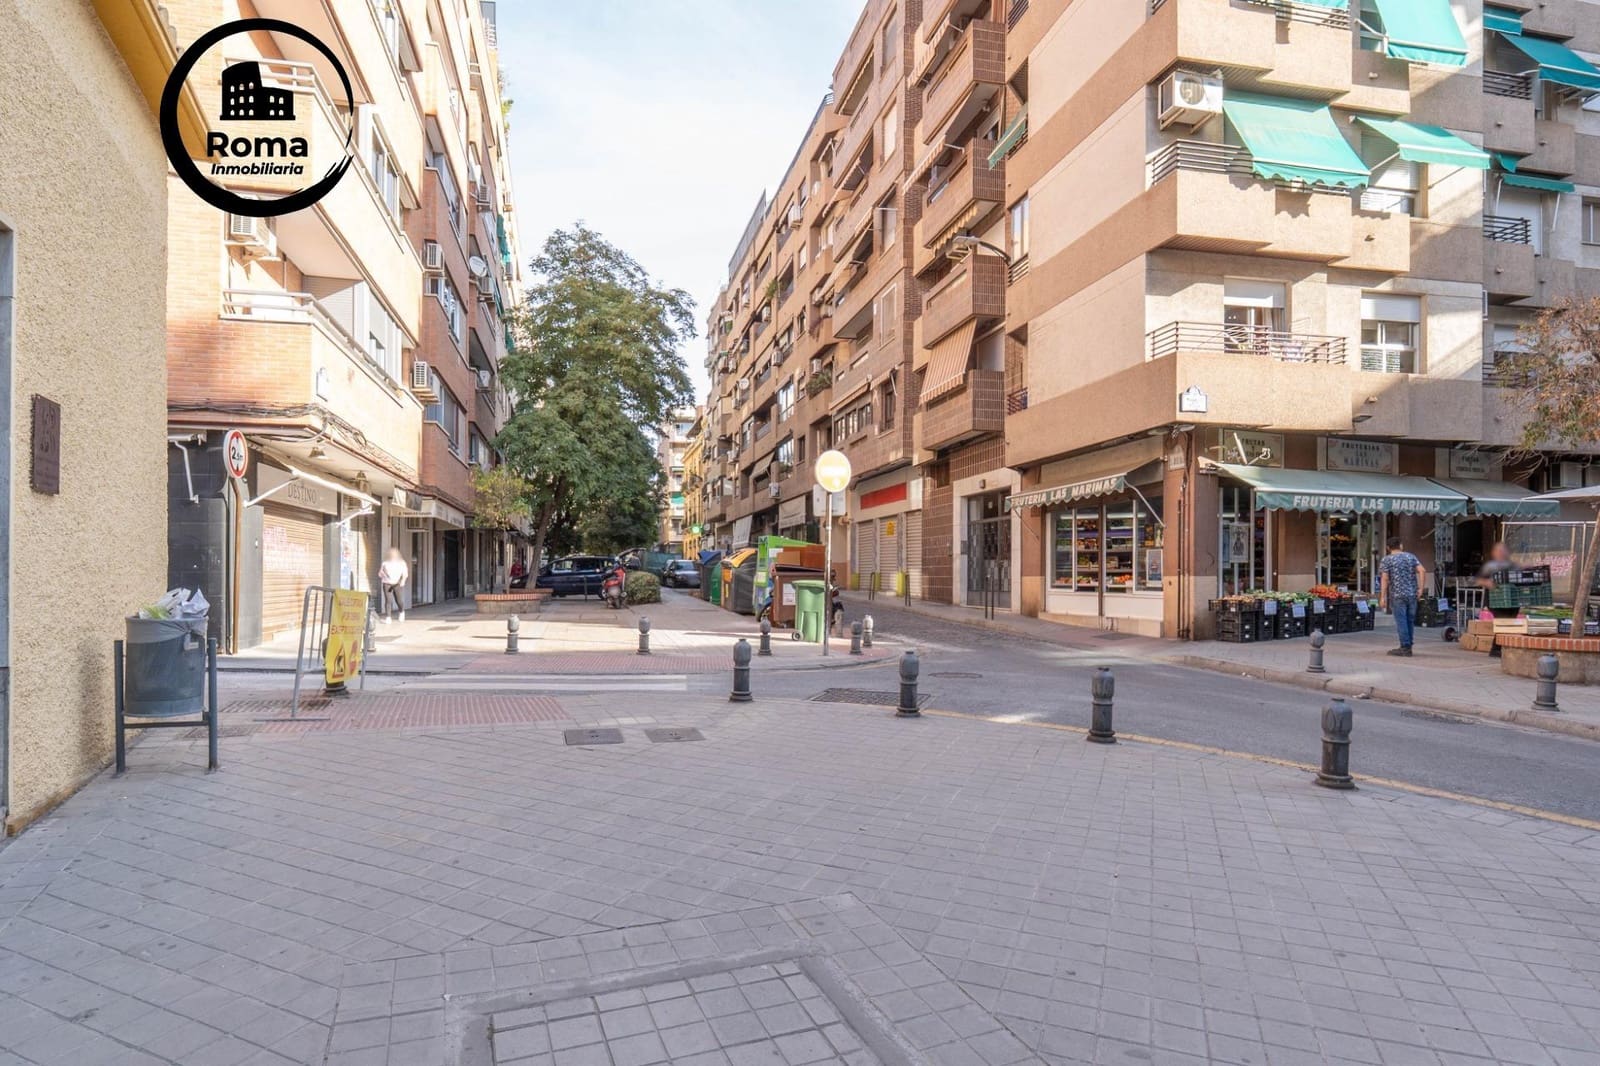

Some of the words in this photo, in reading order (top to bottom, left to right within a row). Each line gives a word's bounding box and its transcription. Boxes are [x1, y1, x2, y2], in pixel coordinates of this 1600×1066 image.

[287, 483, 317, 504] DESTINO
[1050, 488, 1067, 500] LAS
[1071, 478, 1118, 497] MARINAS
[1293, 495, 1354, 508] FRUTERIA
[1361, 498, 1385, 510] LAS
[1391, 499, 1441, 511] MARINAS
